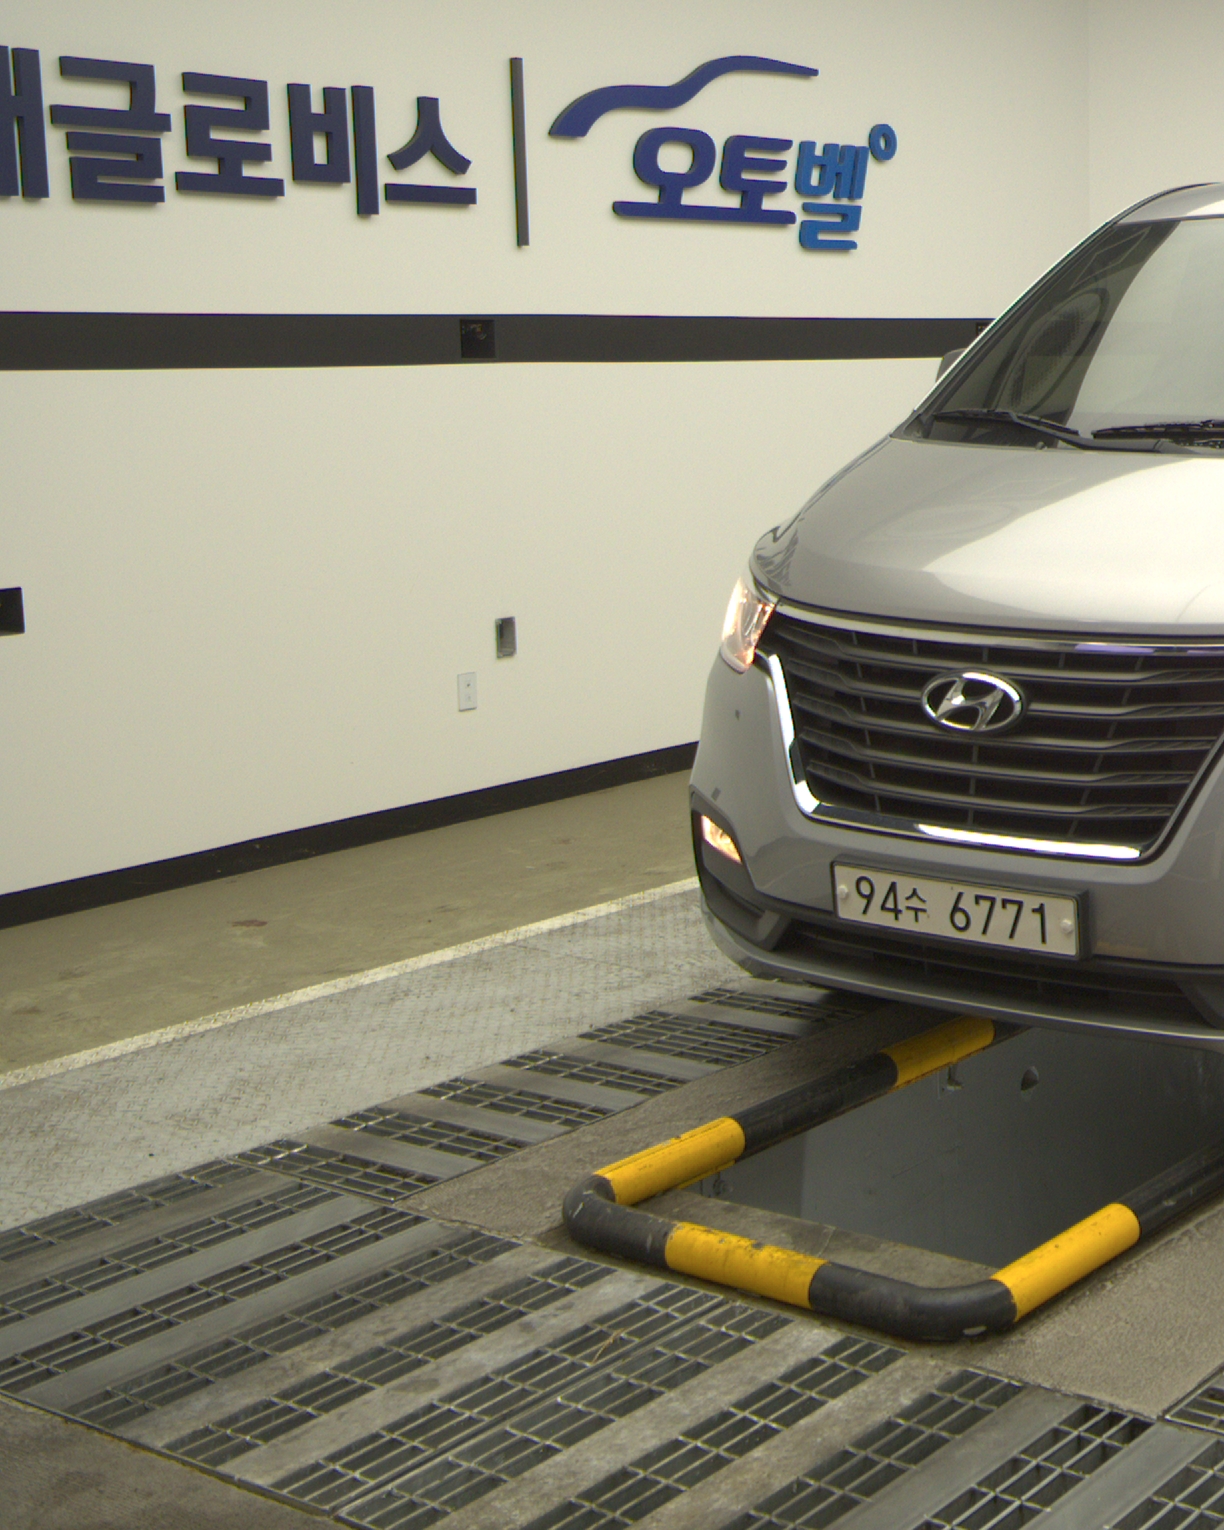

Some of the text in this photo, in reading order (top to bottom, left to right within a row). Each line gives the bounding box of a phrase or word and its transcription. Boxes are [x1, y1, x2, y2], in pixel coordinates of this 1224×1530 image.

[612, 126, 870, 251] 오토벨
[855, 875, 1047, 945] 94수 6771
